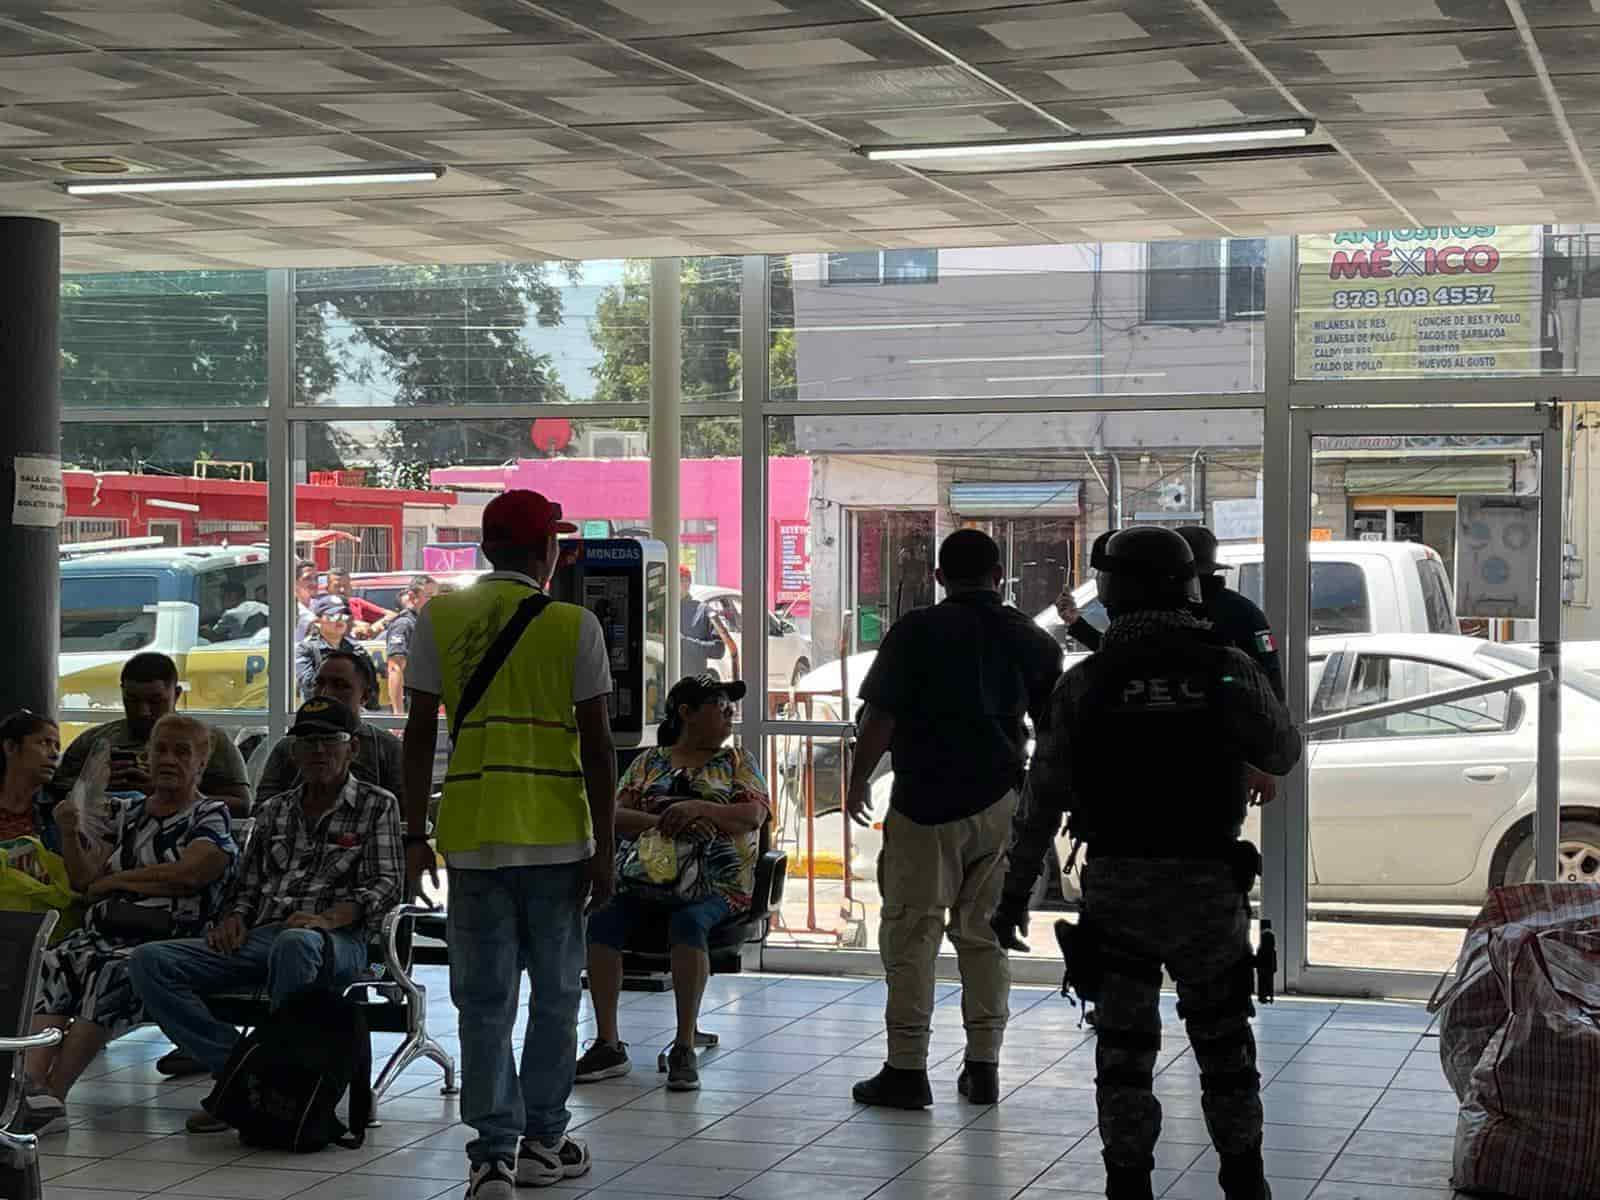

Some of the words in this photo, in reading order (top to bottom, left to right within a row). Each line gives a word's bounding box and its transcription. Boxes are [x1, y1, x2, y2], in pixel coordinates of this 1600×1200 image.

[1329, 242, 1500, 279] MÉXICO
[1334, 289, 1379, 309] 878
[1385, 287, 1428, 307] 108
[1358, 318, 1368, 329] DE
[1418, 316, 1451, 327] LONCHE
[1454, 315, 1465, 325] DE
[1494, 313, 1521, 324] POLLO
[1358, 332, 1368, 344] DE
[1418, 330, 1445, 340] TACOS
[1448, 330, 1457, 340] DE
[1314, 361, 1341, 372] CALDO
[1356, 359, 1383, 371] POLLO
[1417, 358, 1452, 369] HUEVOS
[1455, 357, 1465, 368] AL
[1467, 356, 1496, 367] GUSTO
[586, 548, 640, 560] MONEDAS
